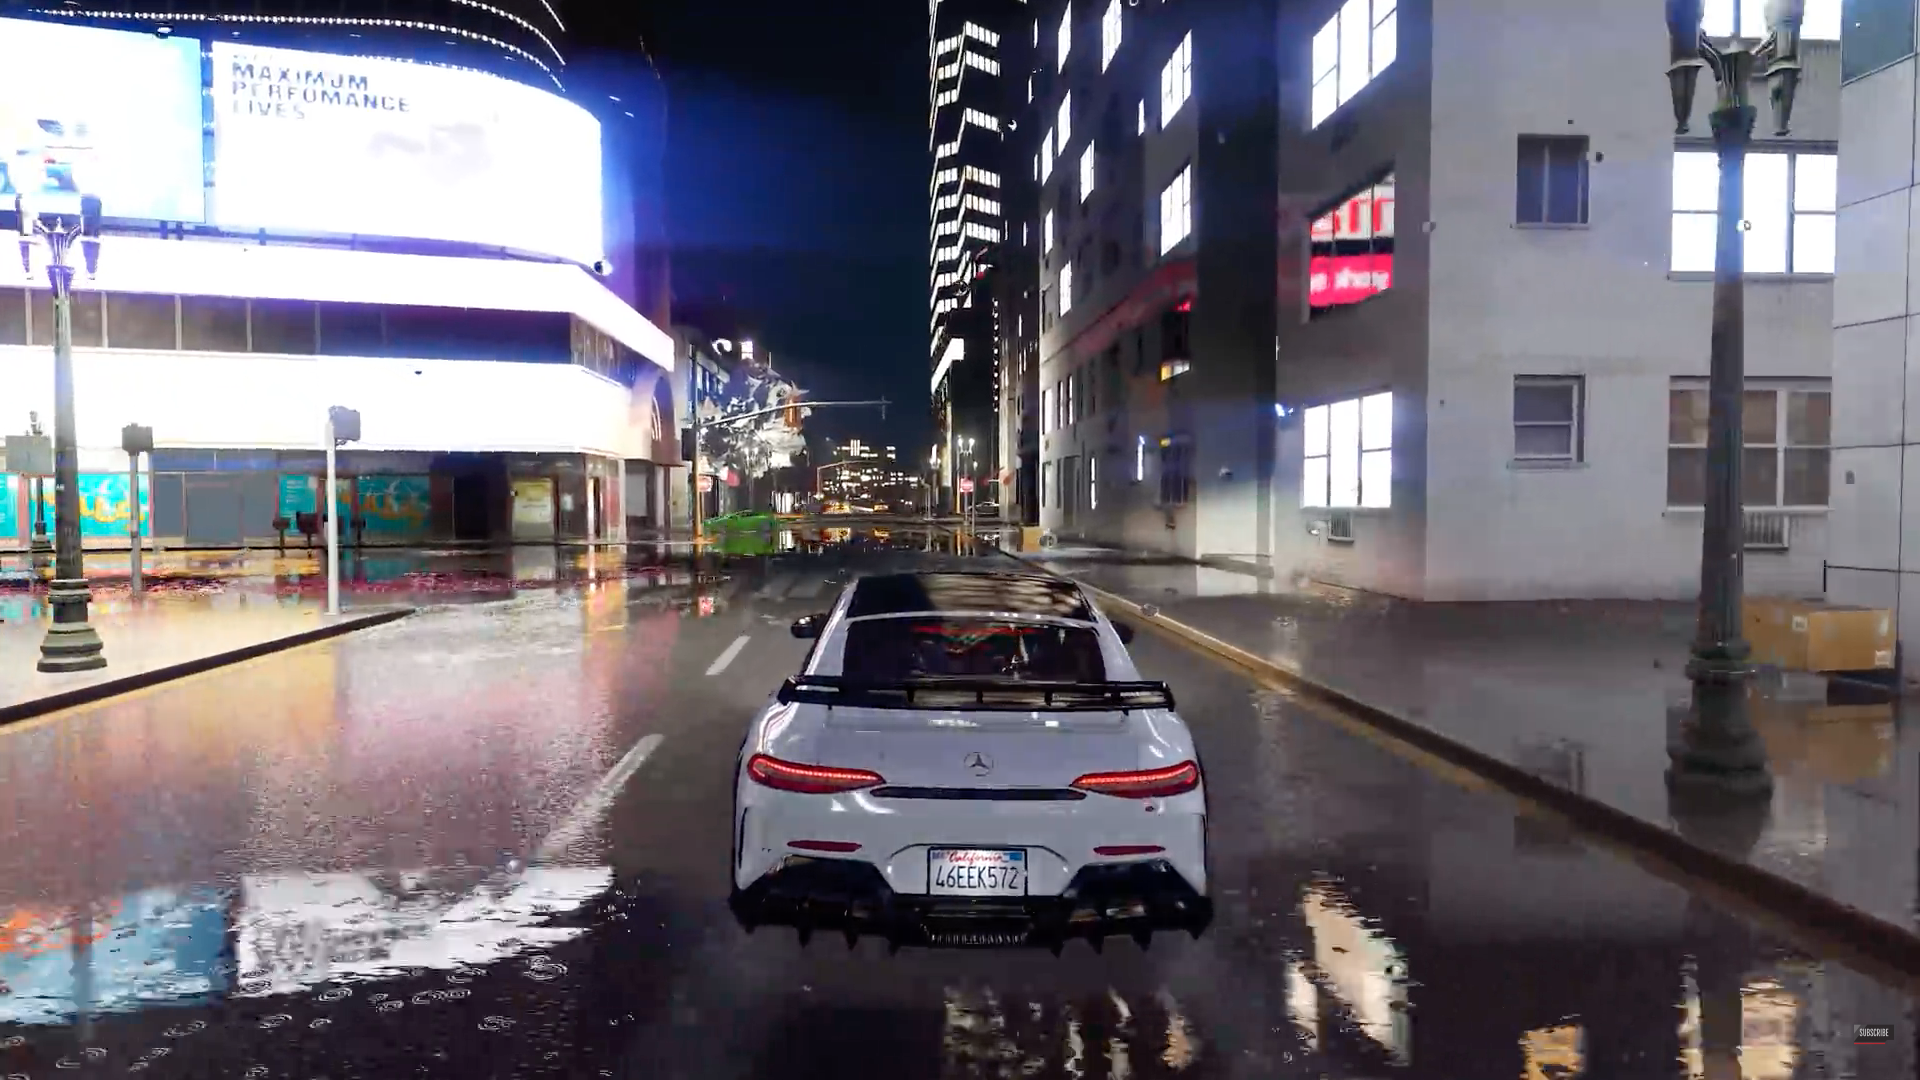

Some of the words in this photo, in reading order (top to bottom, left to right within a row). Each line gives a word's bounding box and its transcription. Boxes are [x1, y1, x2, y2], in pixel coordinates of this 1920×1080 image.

[232, 61, 368, 91] MAXIMUM
[948, 851, 1005, 865] California
[936, 865, 1019, 890] 46EEK572
